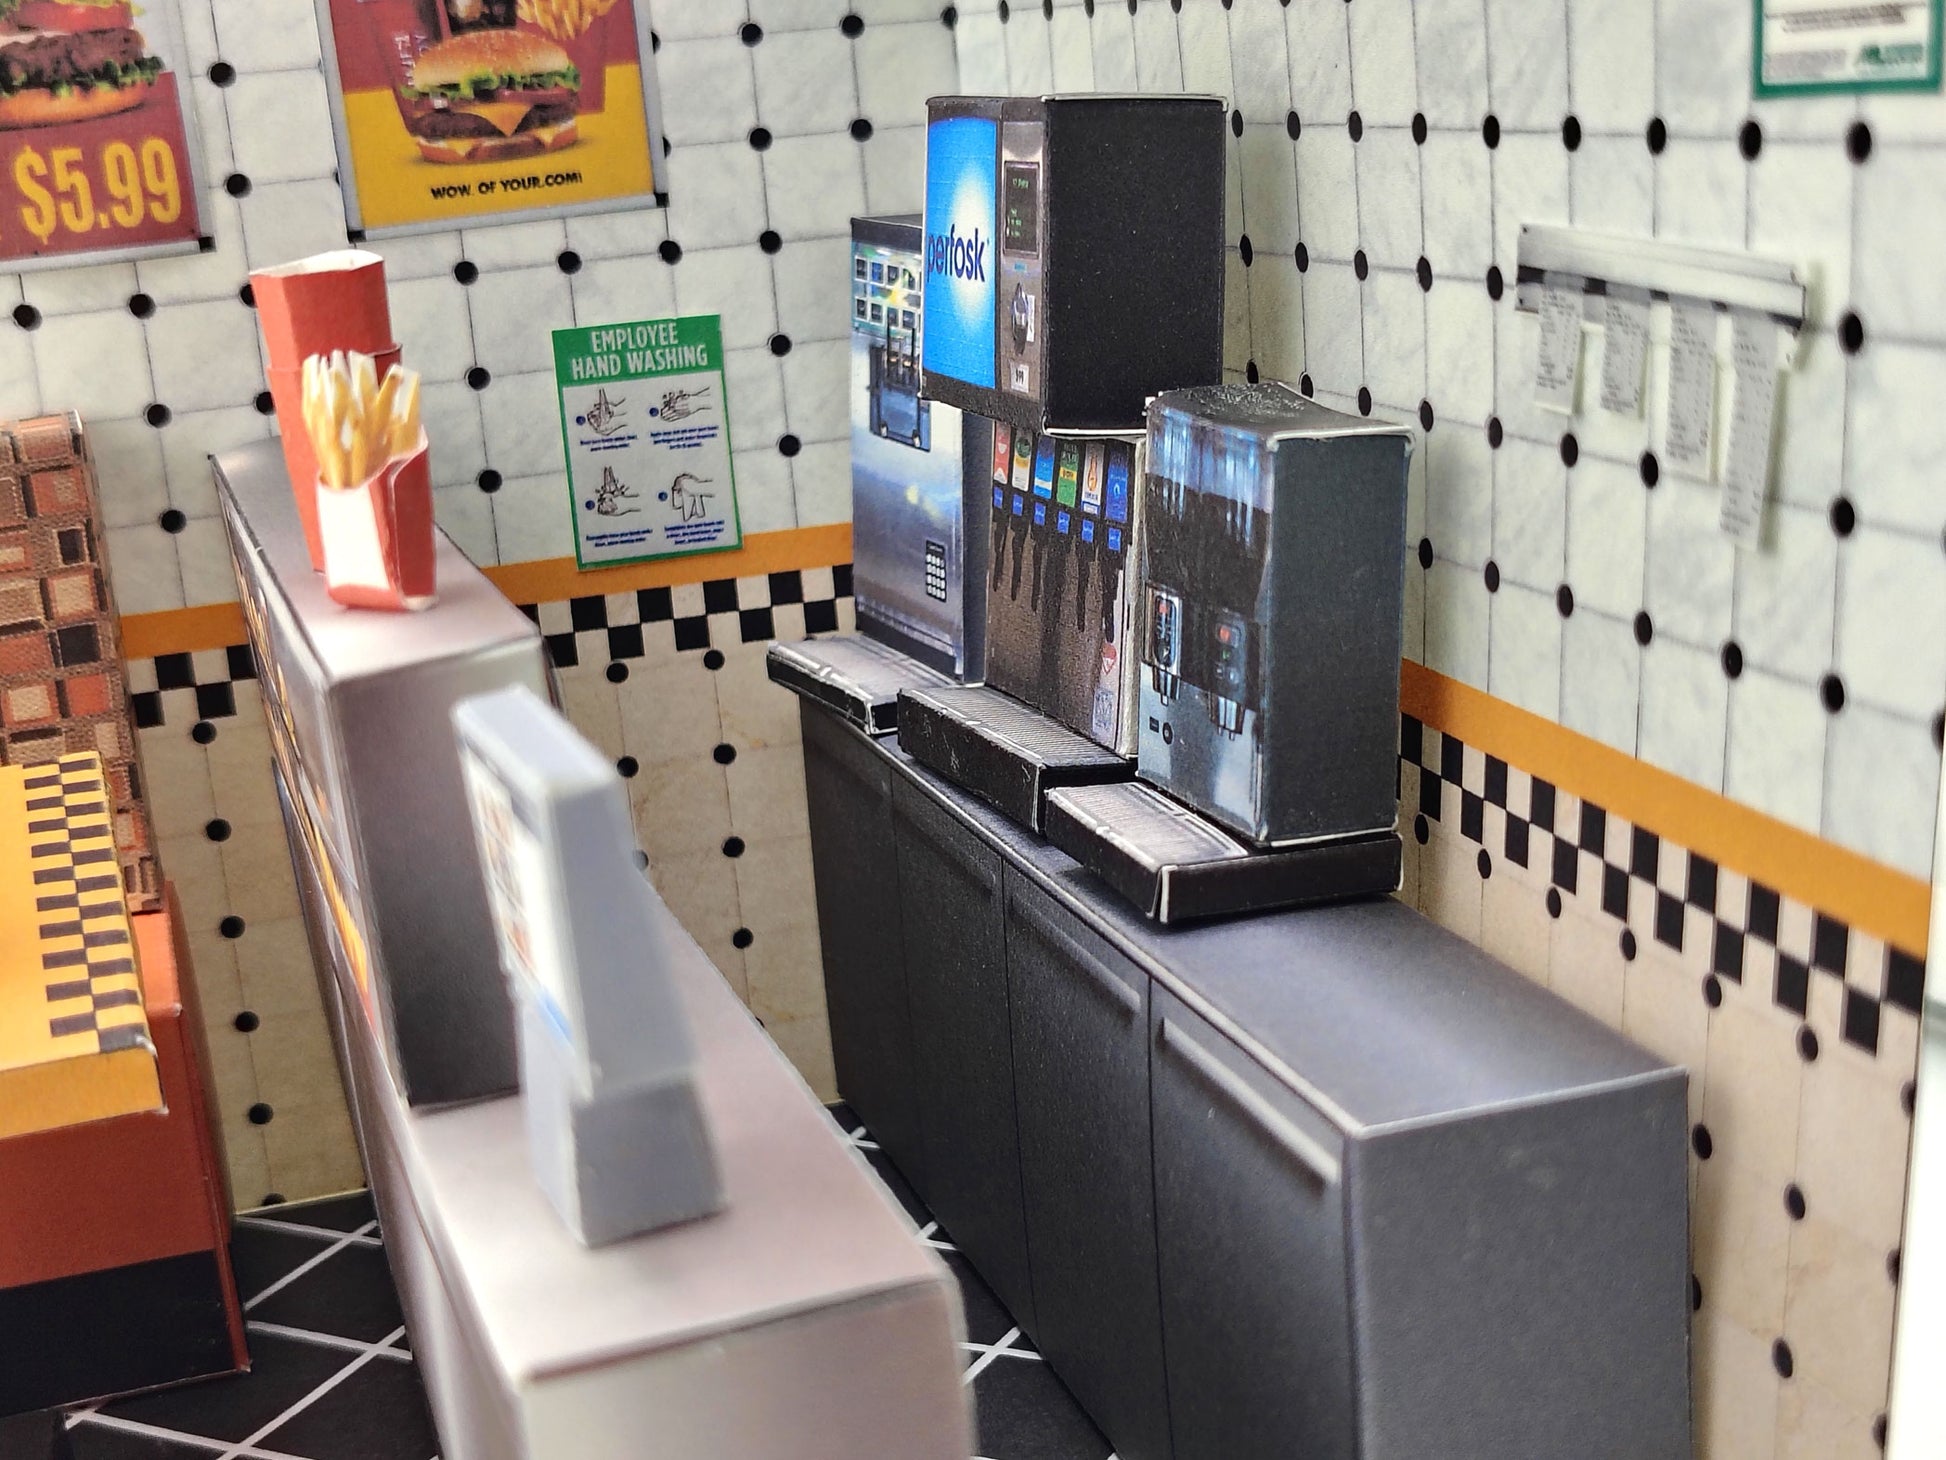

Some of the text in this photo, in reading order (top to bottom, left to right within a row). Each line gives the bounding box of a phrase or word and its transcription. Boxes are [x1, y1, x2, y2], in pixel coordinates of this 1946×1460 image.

[14, 136, 182, 245] $5.99
[478, 181, 497, 195] OF
[927, 223, 986, 283] perfosk
[591, 322, 679, 353] EMPLOYEE
[571, 344, 709, 381] HAND WASHING
